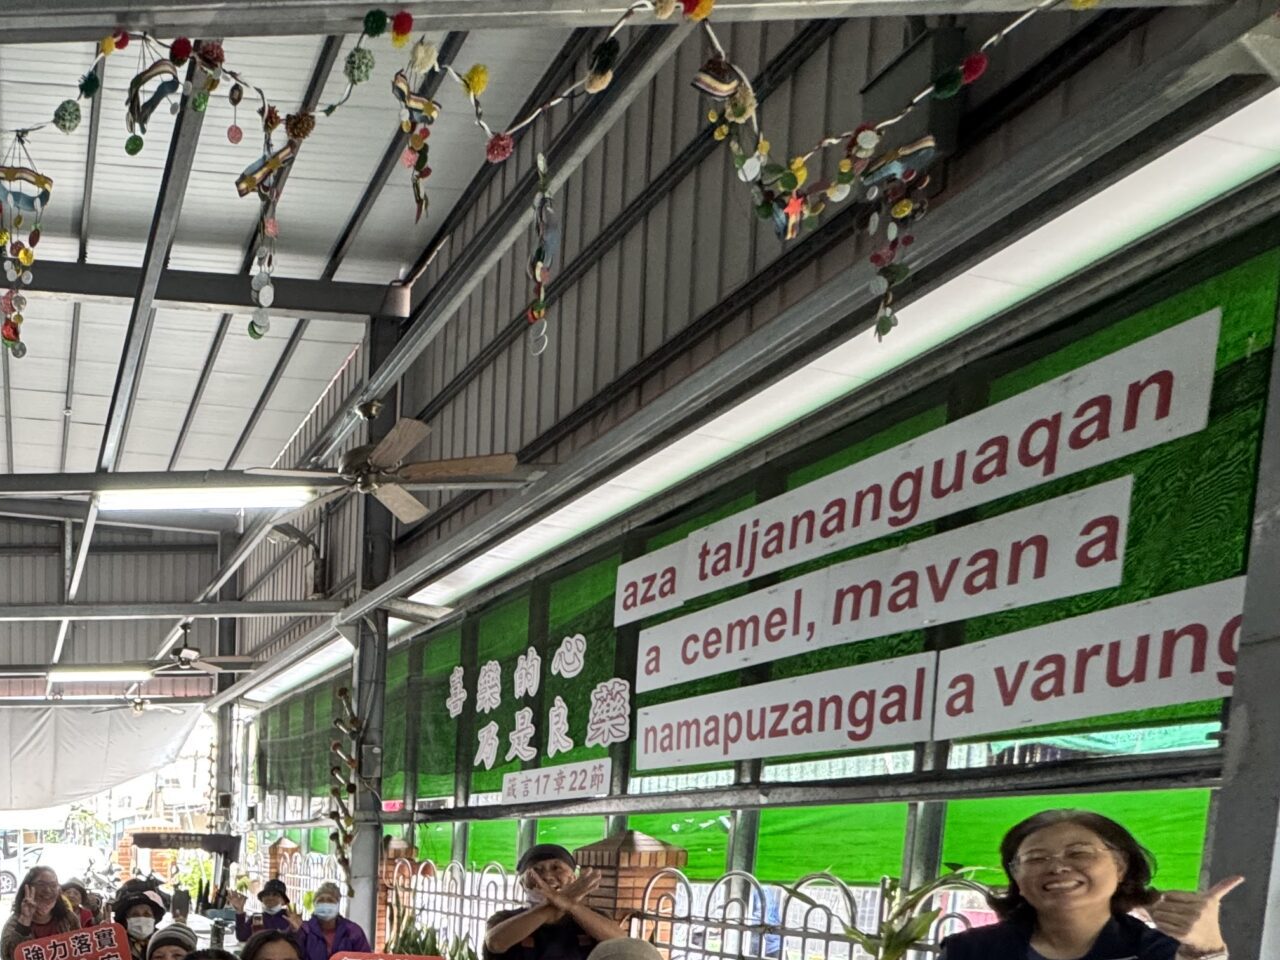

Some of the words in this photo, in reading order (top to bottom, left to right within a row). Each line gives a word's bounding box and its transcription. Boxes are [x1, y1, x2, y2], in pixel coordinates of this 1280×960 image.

[622, 562, 677, 612] aza
[698, 368, 1175, 583] taljananguaqan
[644, 641, 662, 676] a
[681, 590, 816, 667] cemel,
[831, 533, 1047, 626] mavan
[1075, 514, 1119, 567] a
[446, 633, 587, 718] 喜樂的心
[643, 667, 926, 756] namapuzangal
[945, 673, 974, 718] a
[474, 677, 630, 770] 乃是良藥
[507, 764, 605, 799] 箴言17章22節
